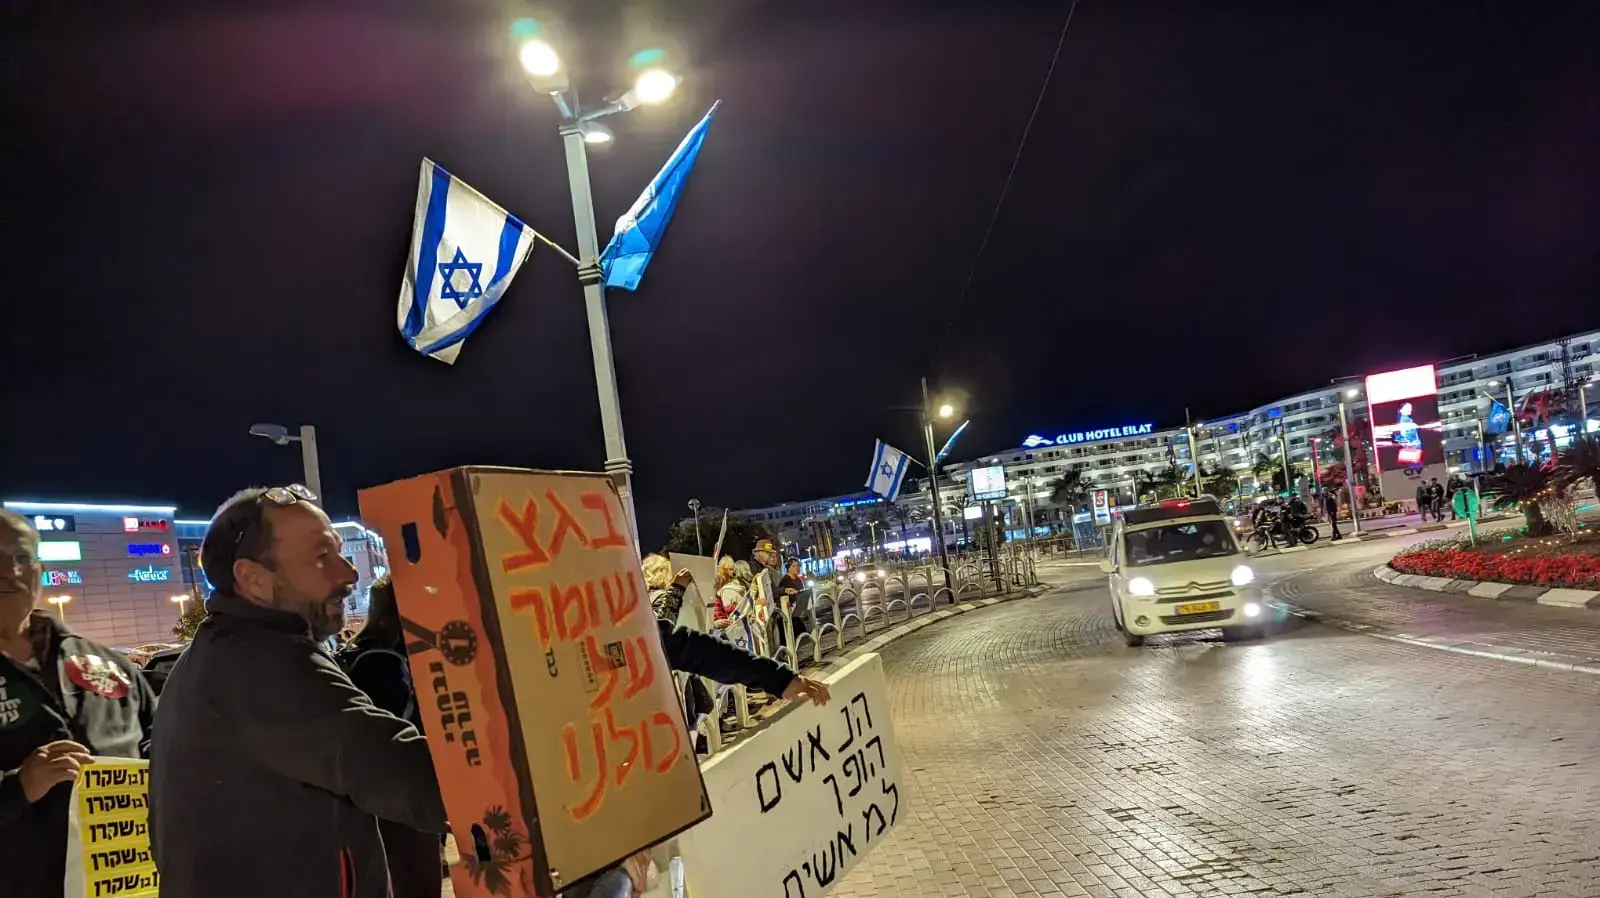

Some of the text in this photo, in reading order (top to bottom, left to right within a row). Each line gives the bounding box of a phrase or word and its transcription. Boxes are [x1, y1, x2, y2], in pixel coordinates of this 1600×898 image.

[1056, 423, 1152, 444] CLUB HOTEL EILAT
[498, 487, 629, 574] בגצ
[509, 568, 640, 650] שומר
[587, 635, 656, 709] על
[563, 706, 682, 823] כולנו
[84, 769, 127, 788] שקרן
[128, 773, 138, 785] בן
[822, 735, 886, 818] הופך
[86, 794, 131, 814] שקרן
[131, 798, 143, 809] בן
[89, 820, 146, 843] בן שקרן
[91, 848, 149, 871] בן שקרן
[94, 874, 140, 897] שקרן
[140, 877, 151, 889] בן
